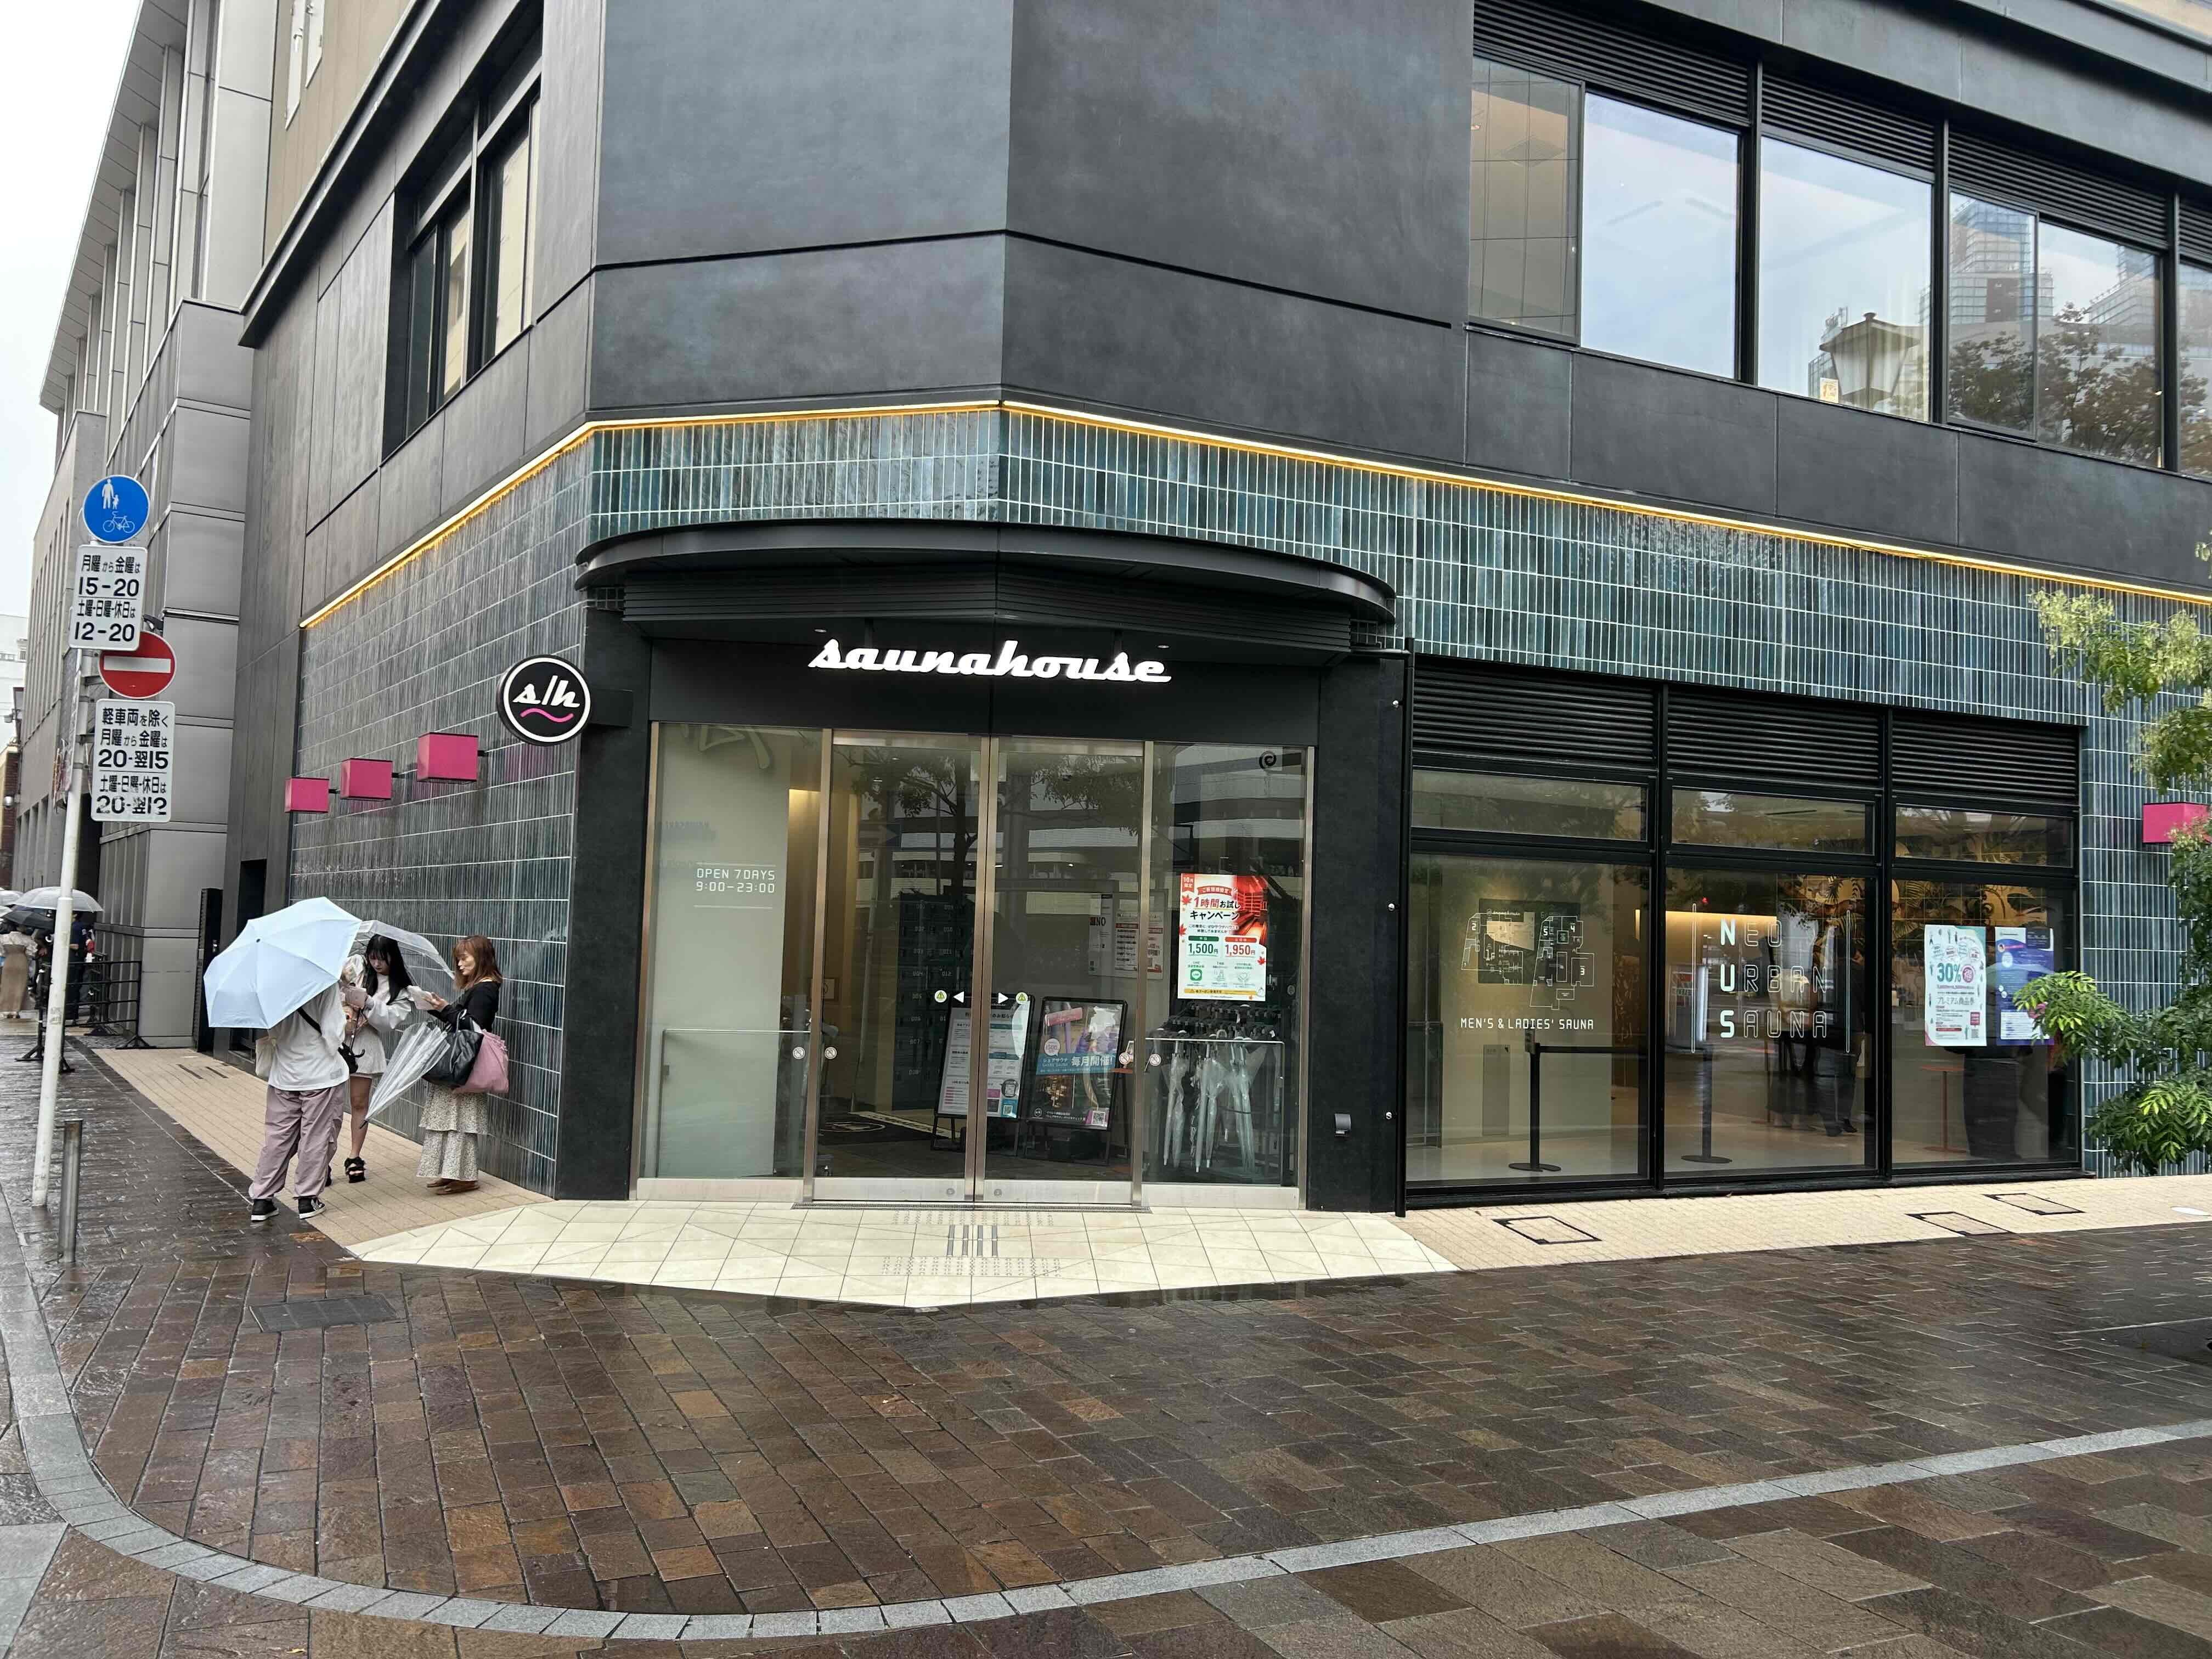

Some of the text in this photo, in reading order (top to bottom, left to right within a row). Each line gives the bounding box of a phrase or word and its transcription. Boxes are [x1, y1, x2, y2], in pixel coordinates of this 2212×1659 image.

[81, 554, 141, 573] 月曜から金曜は
[78, 576, 139, 597] 15-20
[75, 622, 135, 642] 12-20
[808, 639, 1172, 683] saunahouse
[101, 708, 168, 728] 軽車両を除く
[100, 729, 167, 748] 月曜から金曜は
[98, 749, 169, 769] 20-翌15
[696, 868, 729, 879] OPEN
[1193, 896, 1241, 909] 1時間お試し
[1189, 910, 1240, 920] キャンペーン
[1471, 922, 1477, 931] 2
[1570, 924, 1576, 933] 4
[1720, 918, 1782, 947] NEO
[1188, 943, 1219, 955] 1,500円
[1224, 944, 1256, 957] 1,950円
[1720, 964, 1827, 993] URBAN
[1937, 962, 1961, 983] 30%
[1460, 1018, 1594, 1030] MEN'S & LADIES' SAUNA
[1720, 1010, 1827, 1039] SAUNA
[1071, 1055, 1113, 1066] 毎月開催!
